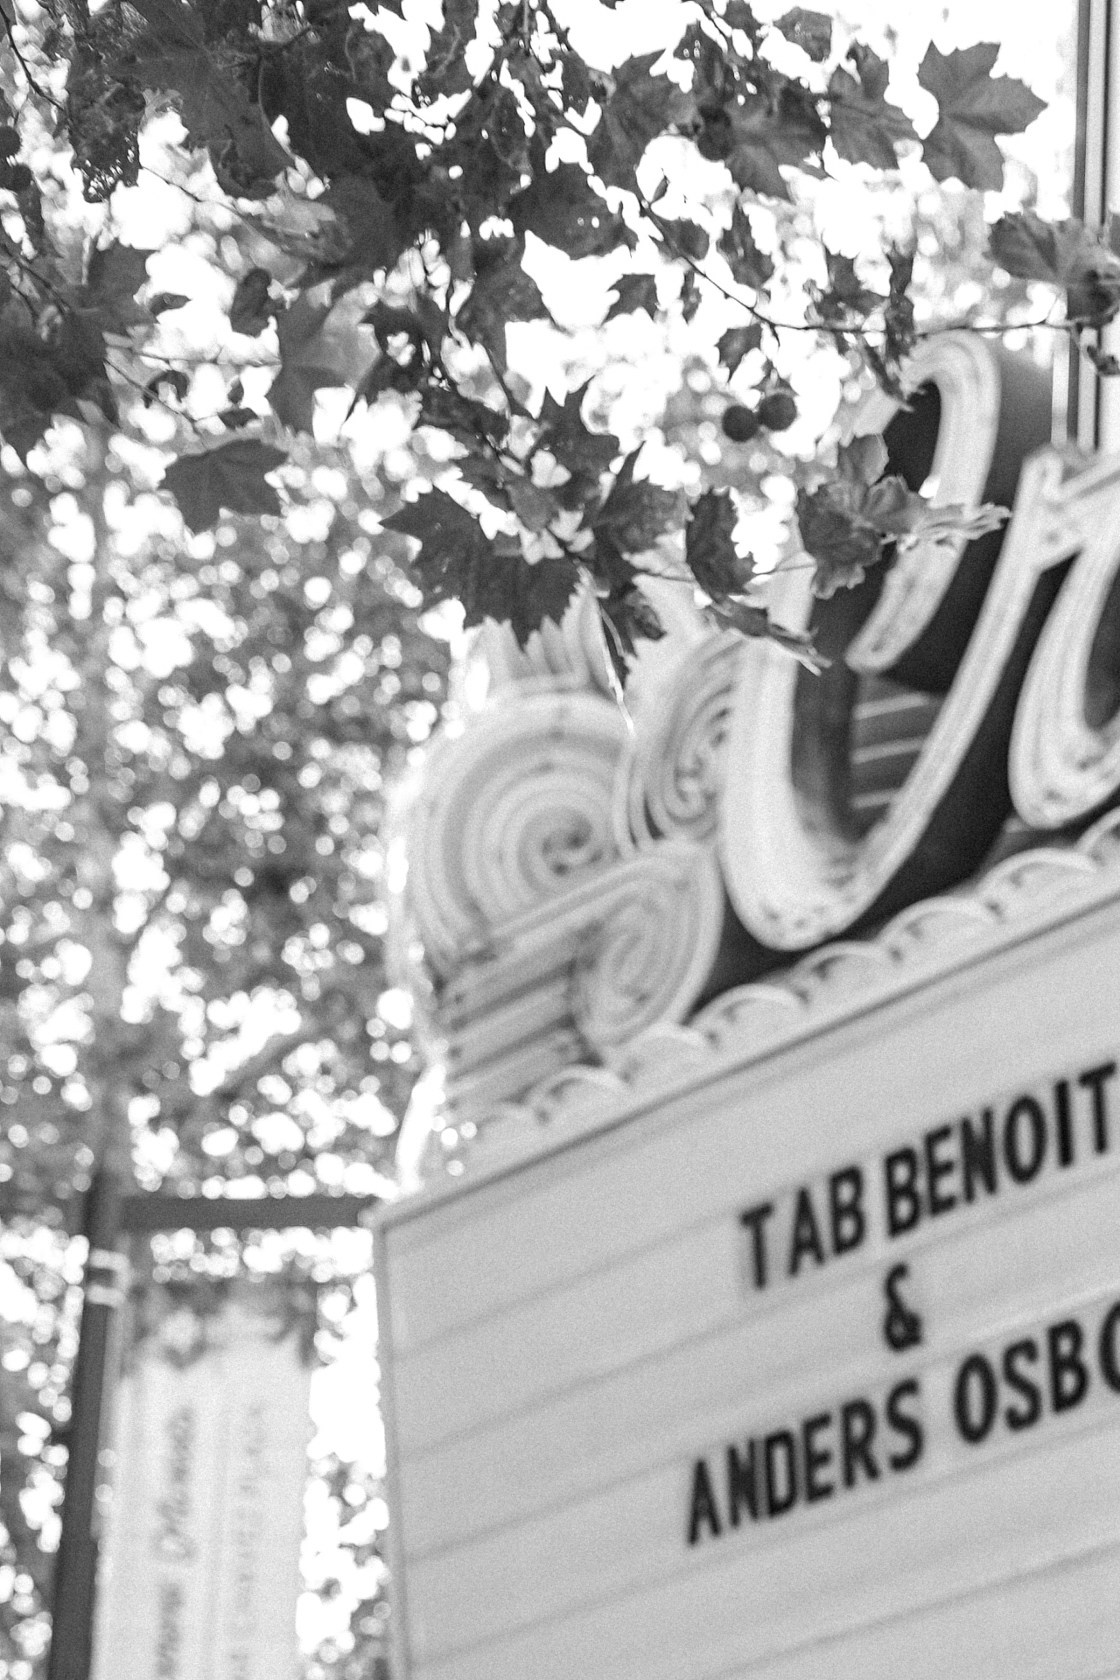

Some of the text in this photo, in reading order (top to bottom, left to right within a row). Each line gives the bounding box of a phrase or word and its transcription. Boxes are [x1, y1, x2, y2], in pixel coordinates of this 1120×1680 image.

[738, 1059, 1119, 1291] TAB BENOIT
[881, 1261, 925, 1355] &
[685, 1376, 926, 1547] ANDERS
